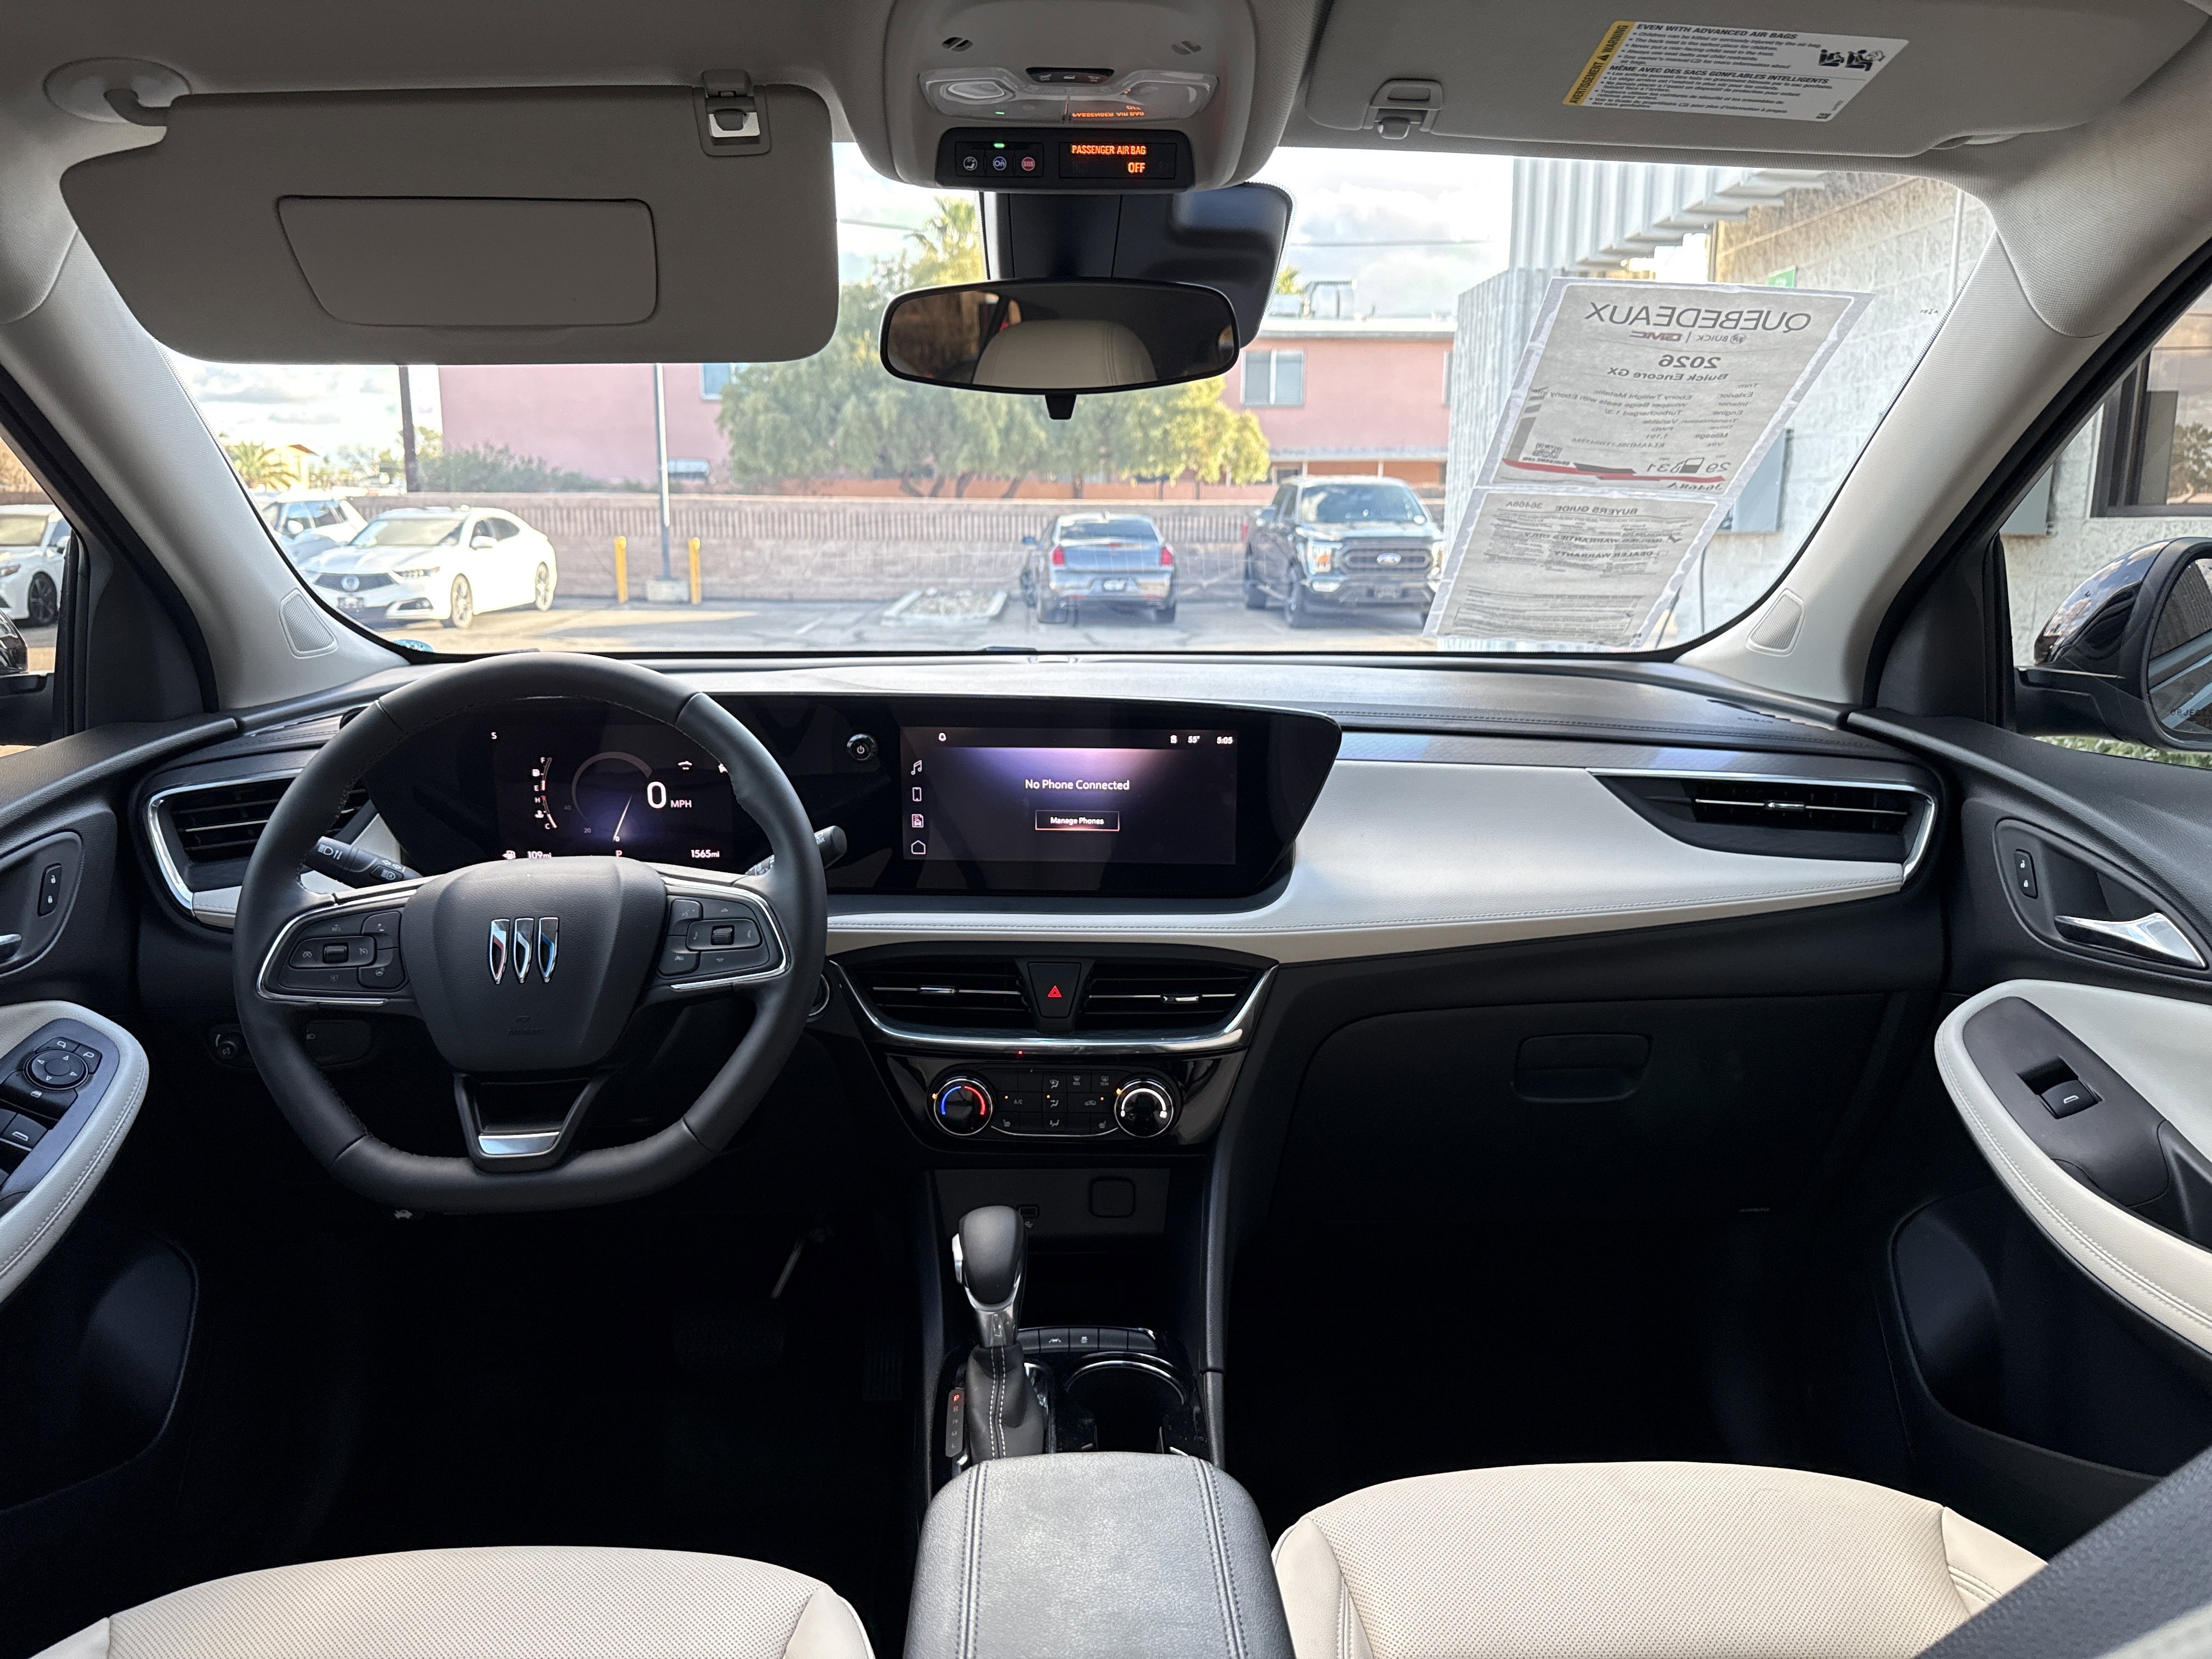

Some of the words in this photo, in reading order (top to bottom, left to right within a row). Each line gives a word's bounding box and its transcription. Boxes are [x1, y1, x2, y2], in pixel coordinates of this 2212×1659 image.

[1693, 27, 1748, 36] ADVANCED
[1569, 61, 1604, 104] AVERTISSEMENT
[1601, 25, 1628, 53] WARNING
[1709, 71, 1767, 80] GONFLABLES
[1767, 75, 1830, 83] INTELLIGENTS
[1071, 145, 1114, 155] PASSENGER
[1116, 145, 1130, 155] AIR
[1131, 146, 1146, 155] BAG
[1128, 162, 1146, 173] OFF
[1025, 779, 1040, 789] No
[1042, 779, 1073, 789] Phone
[1076, 780, 1130, 790] Connected
[647, 781, 667, 809] 0
[670, 800, 692, 808] MPH
[1050, 816, 1078, 825] Manage
[691, 850, 720, 858] 1565mi
